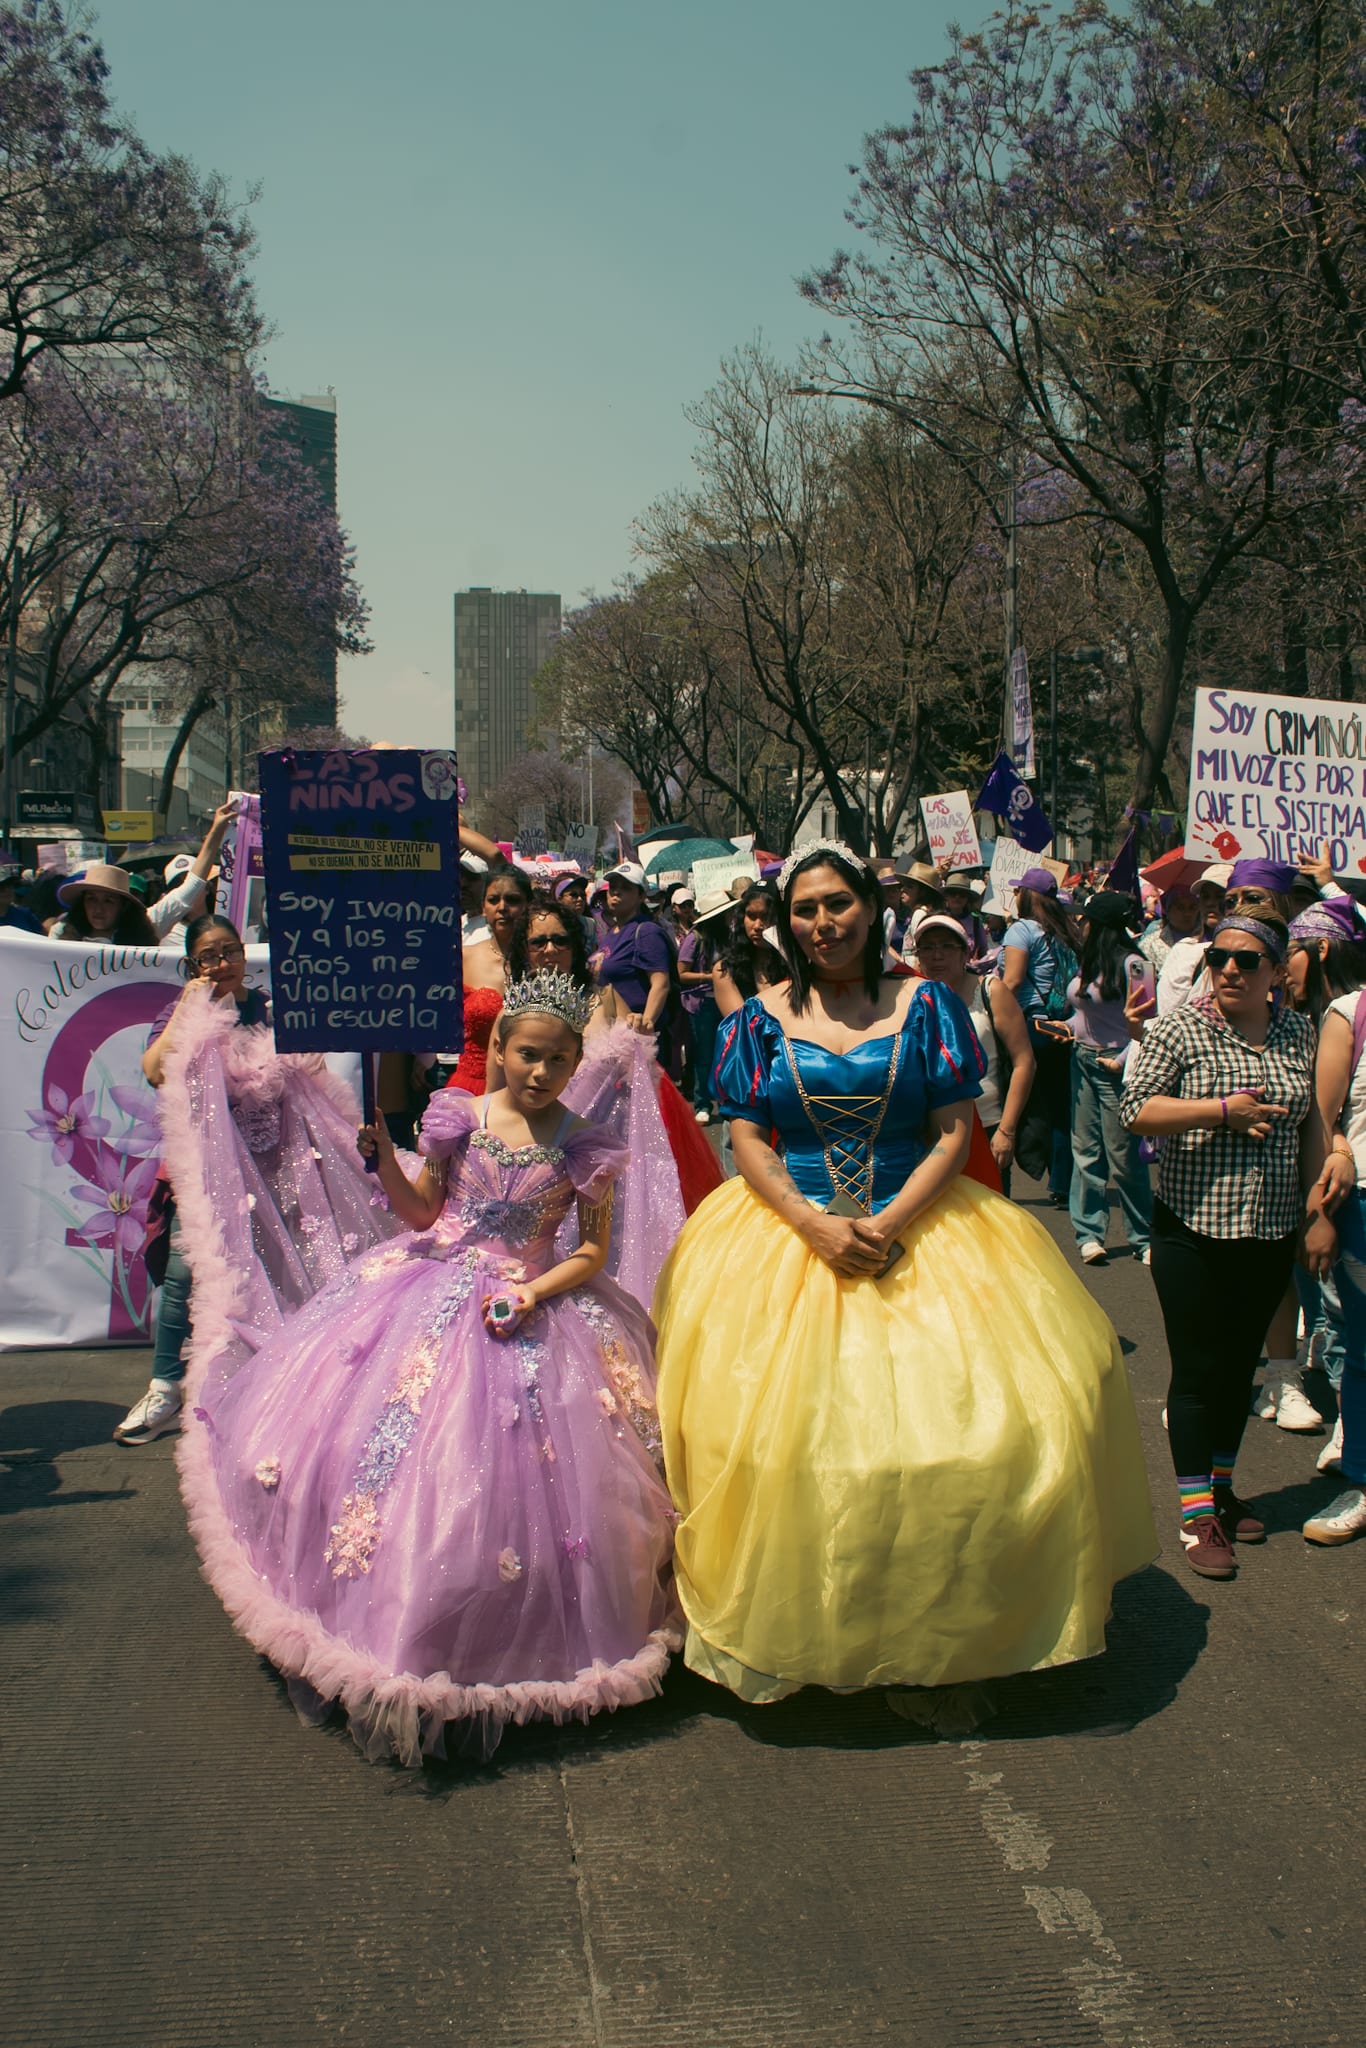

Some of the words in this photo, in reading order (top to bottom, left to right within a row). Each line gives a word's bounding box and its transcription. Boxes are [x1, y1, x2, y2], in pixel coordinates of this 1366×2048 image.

[1207, 690, 1257, 736] SOY
[1264, 708, 1366, 761] CRIMINÓL
[289, 751, 379, 783] LAS
[1197, 749, 1228, 782] MI
[1231, 750, 1277, 787] VOZ
[1279, 760, 1306, 793] ES
[1315, 763, 1354, 798] POR
[289, 773, 416, 814] NIÑAS
[926, 798, 950, 815] LAS
[1195, 790, 1236, 826] QUE
[1242, 793, 1270, 829] EL
[1274, 795, 1366, 840] SISTEMA
[567, 823, 585, 838] NO
[930, 834, 946, 849] NO
[952, 828, 973, 846] SE
[364, 840, 375, 850] NO
[376, 840, 388, 852] SE
[390, 841, 434, 853] VENDEN
[934, 849, 979, 867] TCAN
[309, 858, 316, 867] NO
[318, 857, 325, 867] SE
[358, 856, 368, 867] NO
[371, 855, 381, 867] SE
[384, 853, 421, 868] MATAN
[278, 891, 335, 924] Soy
[347, 900, 454, 928] Ivanna
[283, 929, 301, 956] y
[312, 928, 331, 949] a
[345, 925, 386, 948] los
[280, 954, 350, 976] años
[372, 955, 420, 973] me
[426, 984, 456, 1001] en
[284, 1008, 316, 1029] mi
[327, 1003, 438, 1031] escuela
